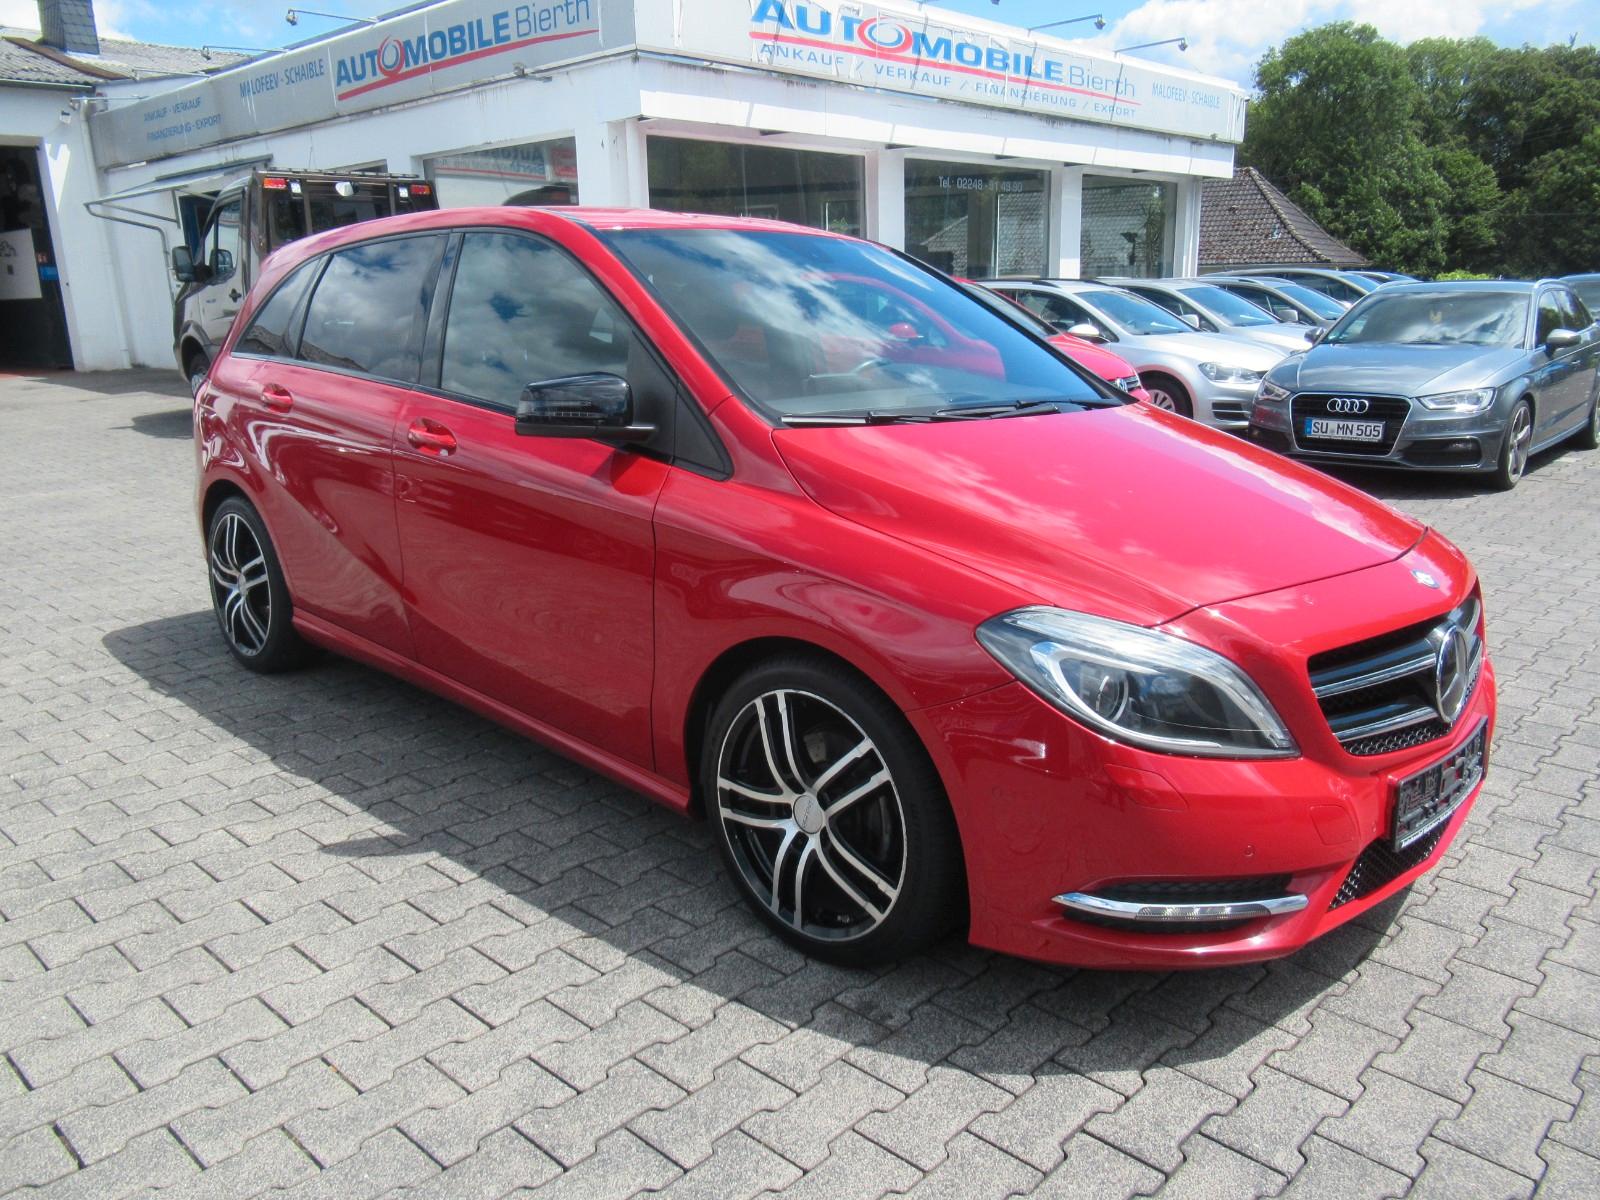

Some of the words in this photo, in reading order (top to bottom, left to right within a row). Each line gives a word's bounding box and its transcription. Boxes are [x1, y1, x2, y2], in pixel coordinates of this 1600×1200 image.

[336, 11, 511, 87] AUTOMOBILE
[515, 0, 590, 38] Bierth
[751, 0, 1064, 83] AUTOMOBILE
[1069, 65, 1136, 97] Bierth
[285, 59, 325, 85] SCHAIBLE
[760, 43, 845, 66] ANKAUF
[874, 63, 952, 87] VERKAUF
[975, 82, 1077, 108] FINANZIERUNG
[1094, 103, 1136, 118] EXPORT
[172, 97, 202, 114] VERKAUF
[195, 114, 223, 130] EXPORT
[957, 177, 983, 190] 02248
[1312, 421, 1328, 434] SU
[1336, 423, 1354, 435] MN
[1356, 424, 1381, 437] 505
